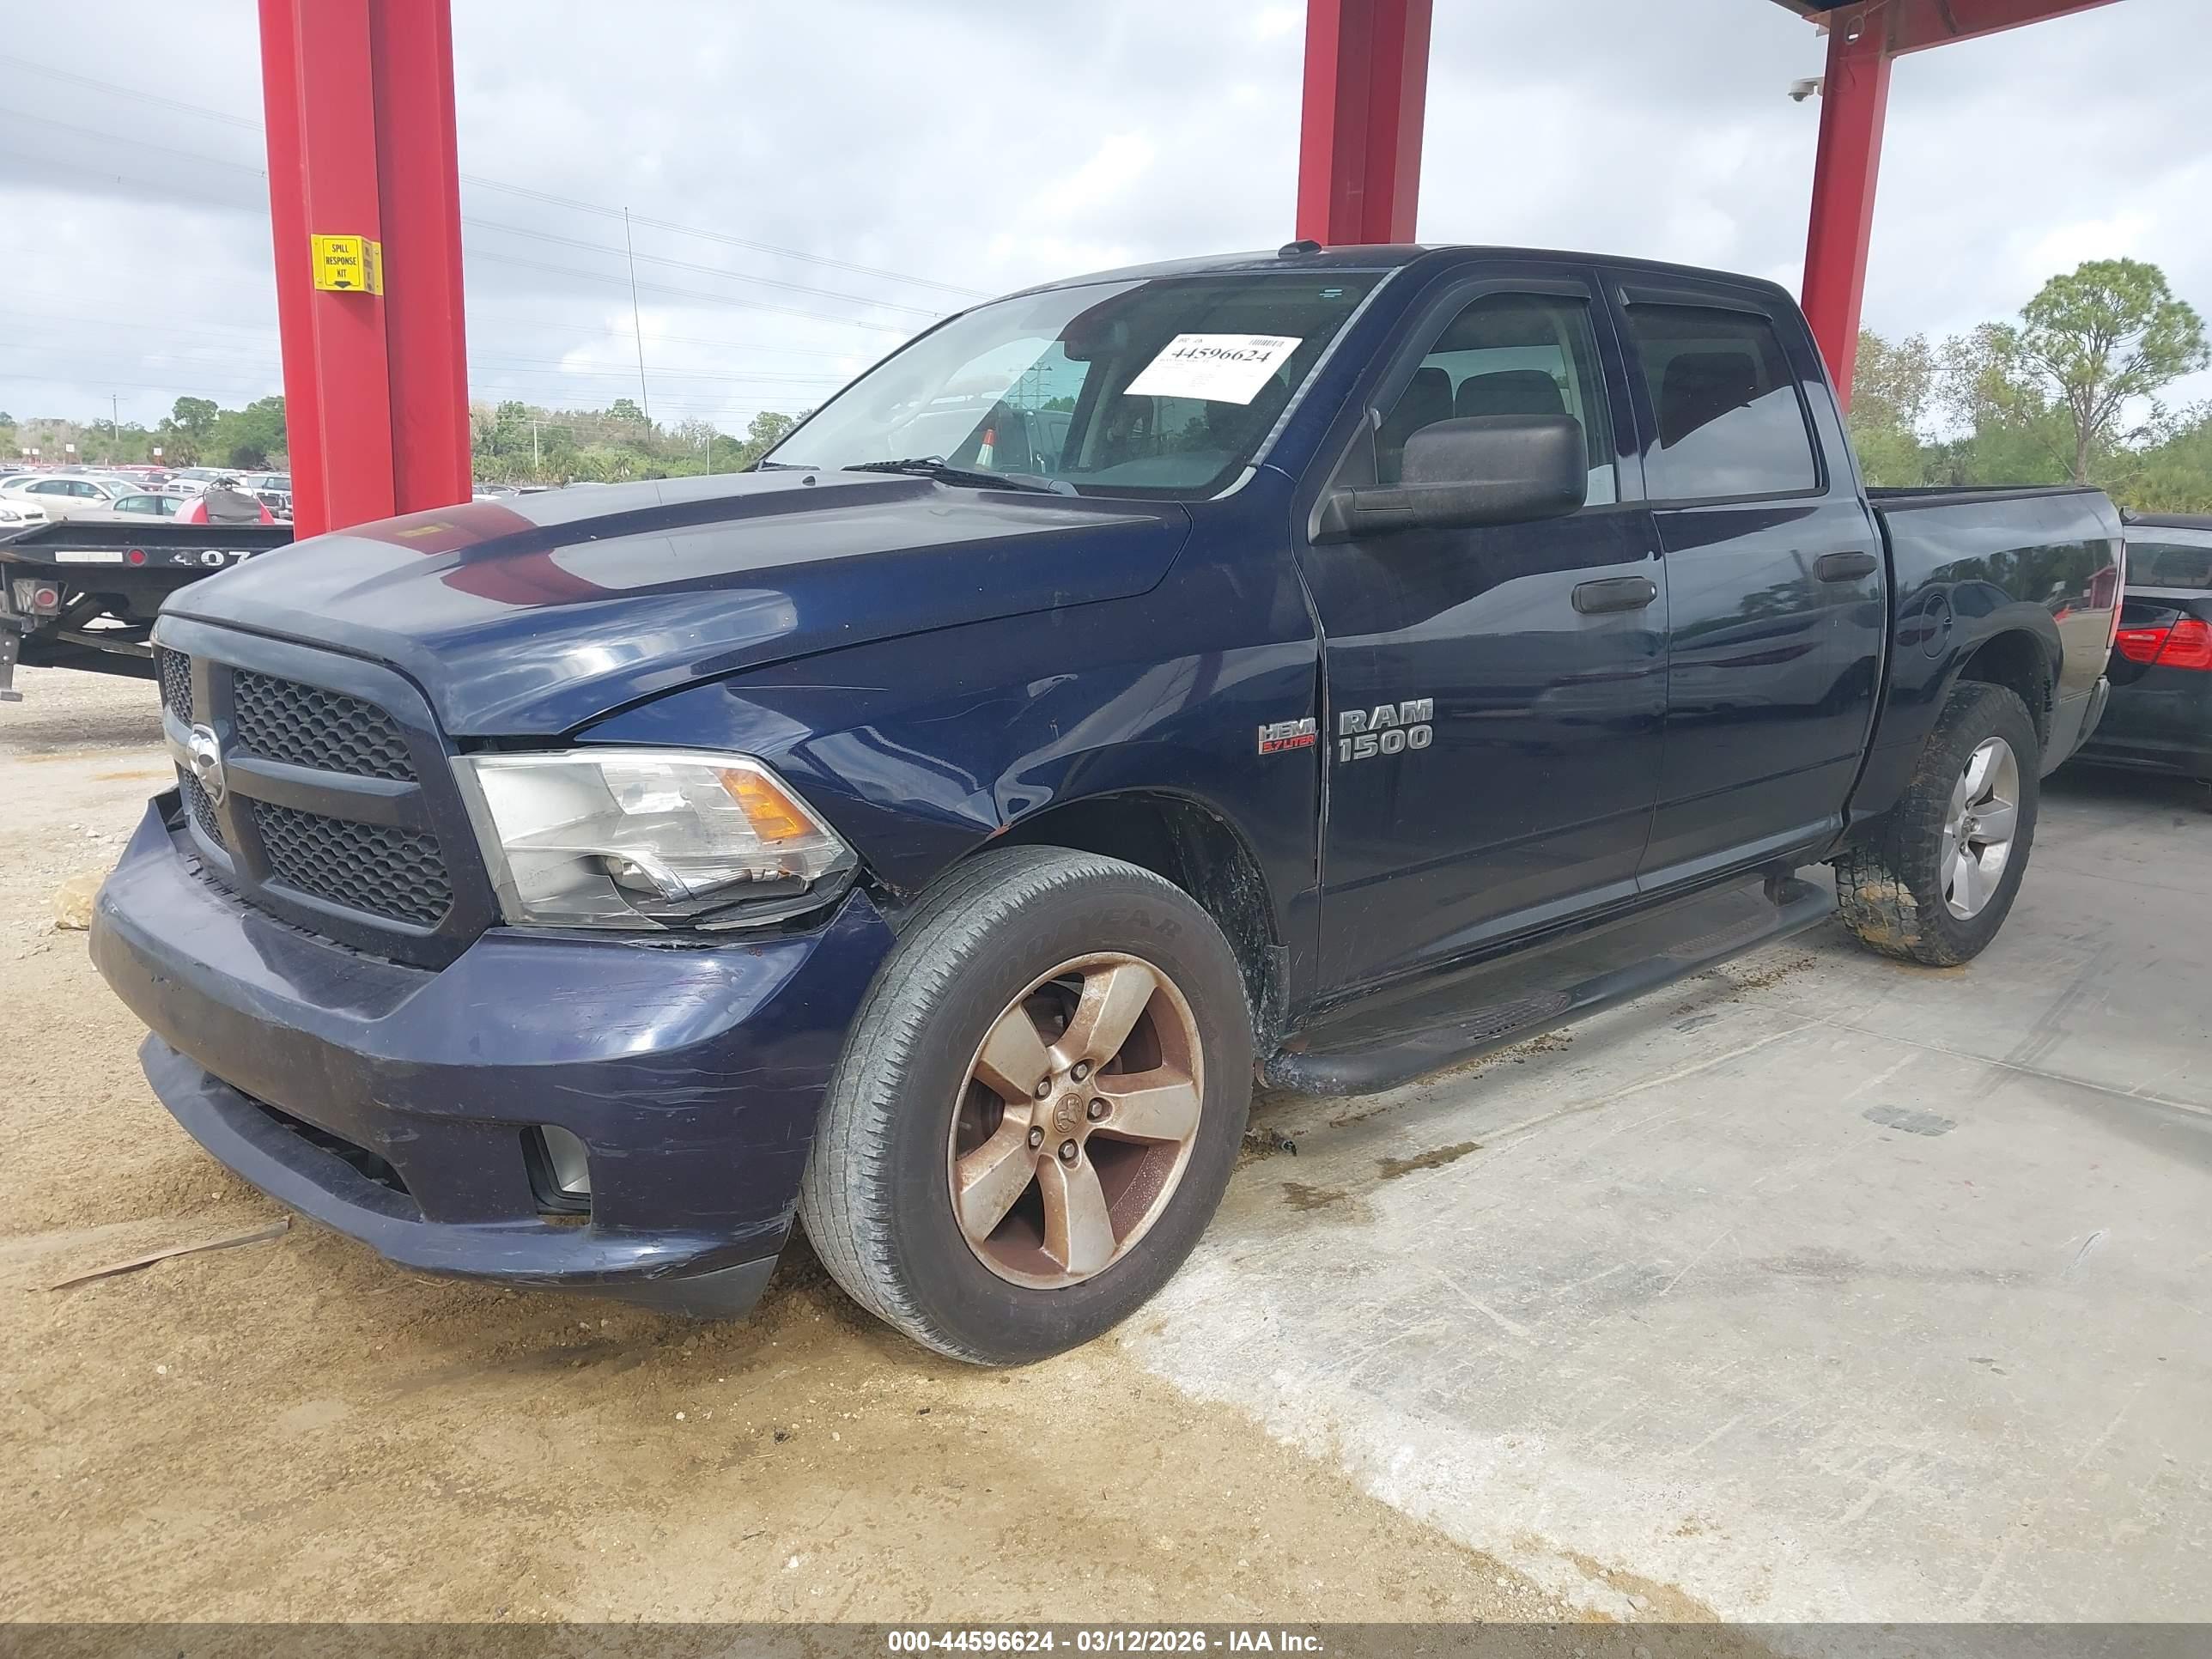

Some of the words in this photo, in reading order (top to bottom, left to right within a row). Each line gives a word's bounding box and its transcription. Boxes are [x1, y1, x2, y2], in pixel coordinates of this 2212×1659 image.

[331, 244, 349, 253] SPILL
[325, 256, 357, 265] RESPONSE
[337, 269, 347, 277] KIT
[1171, 347, 1273, 362] 44596624
[1339, 697, 1434, 736] RAM
[1259, 717, 1316, 741] HEMI
[1263, 739, 1282, 752] 5.7
[1285, 734, 1315, 750] LITER
[1339, 725, 1433, 763] 1500
